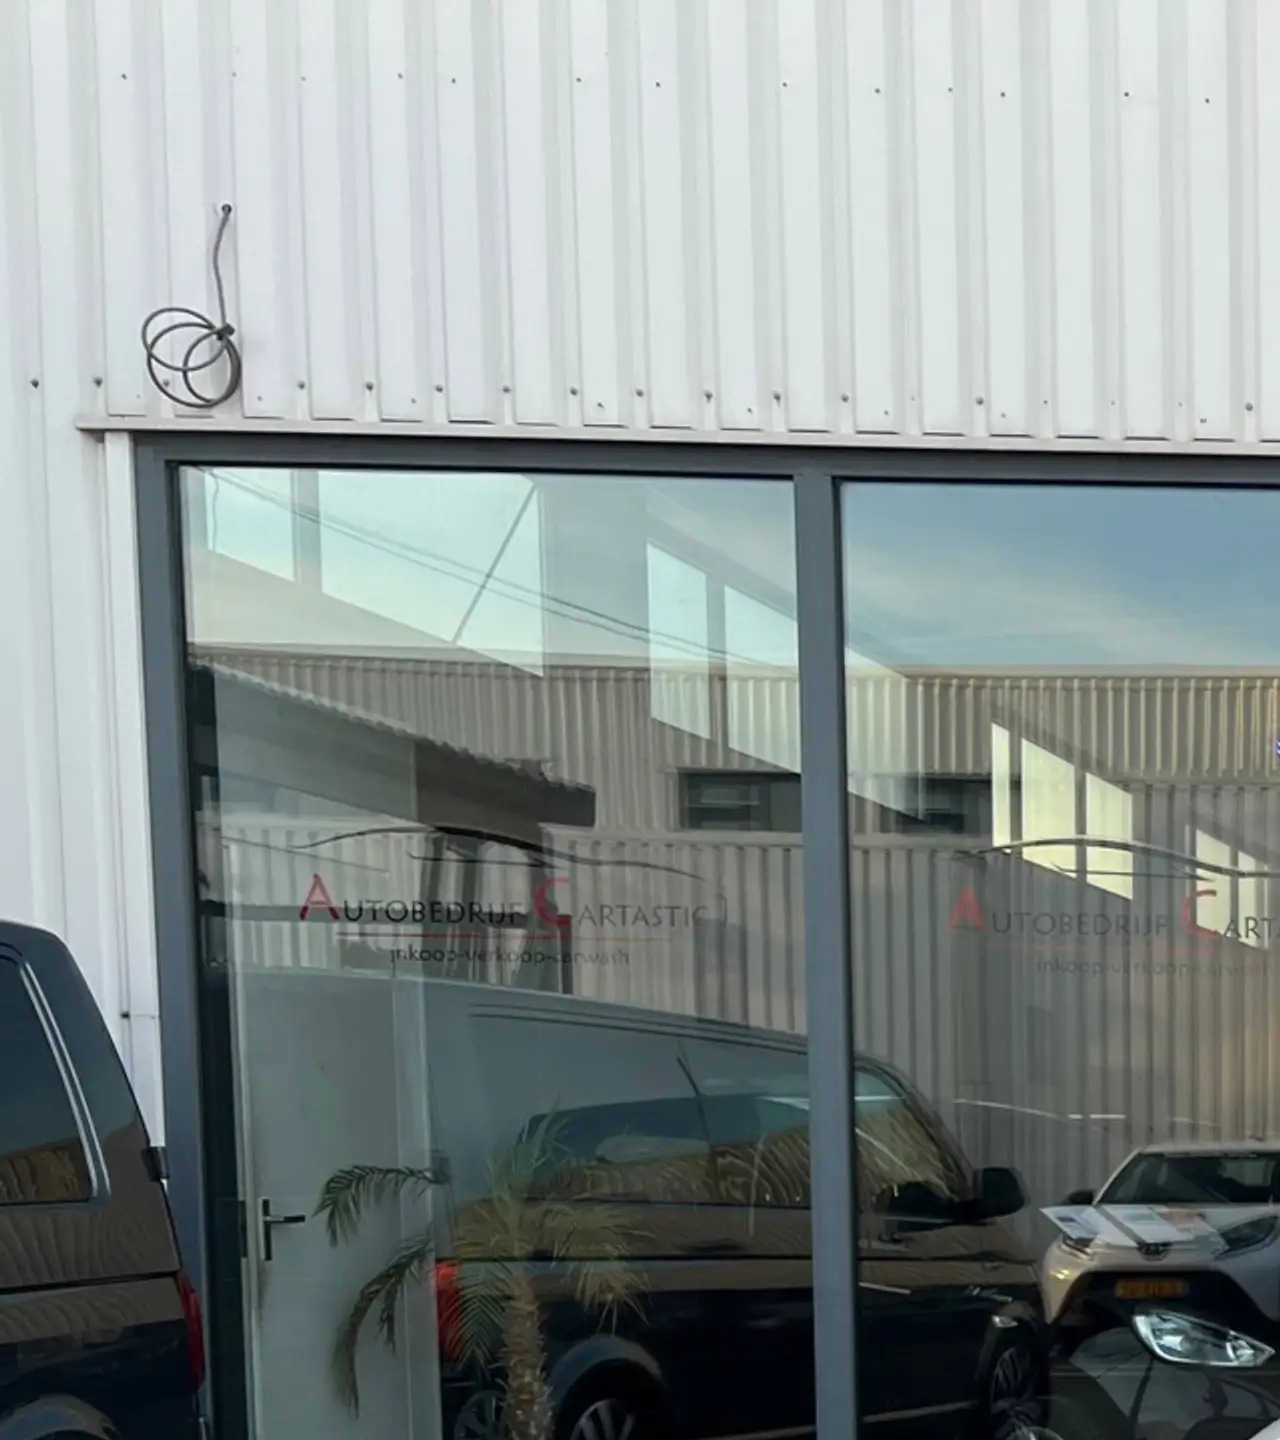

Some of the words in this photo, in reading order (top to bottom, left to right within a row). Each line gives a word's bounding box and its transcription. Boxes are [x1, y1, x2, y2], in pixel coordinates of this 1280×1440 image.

[299, 873, 527, 926] AUTOBEDRIJF
[533, 876, 709, 929] CARTASTIC
[949, 887, 1168, 938] AUTOBEDRIJF
